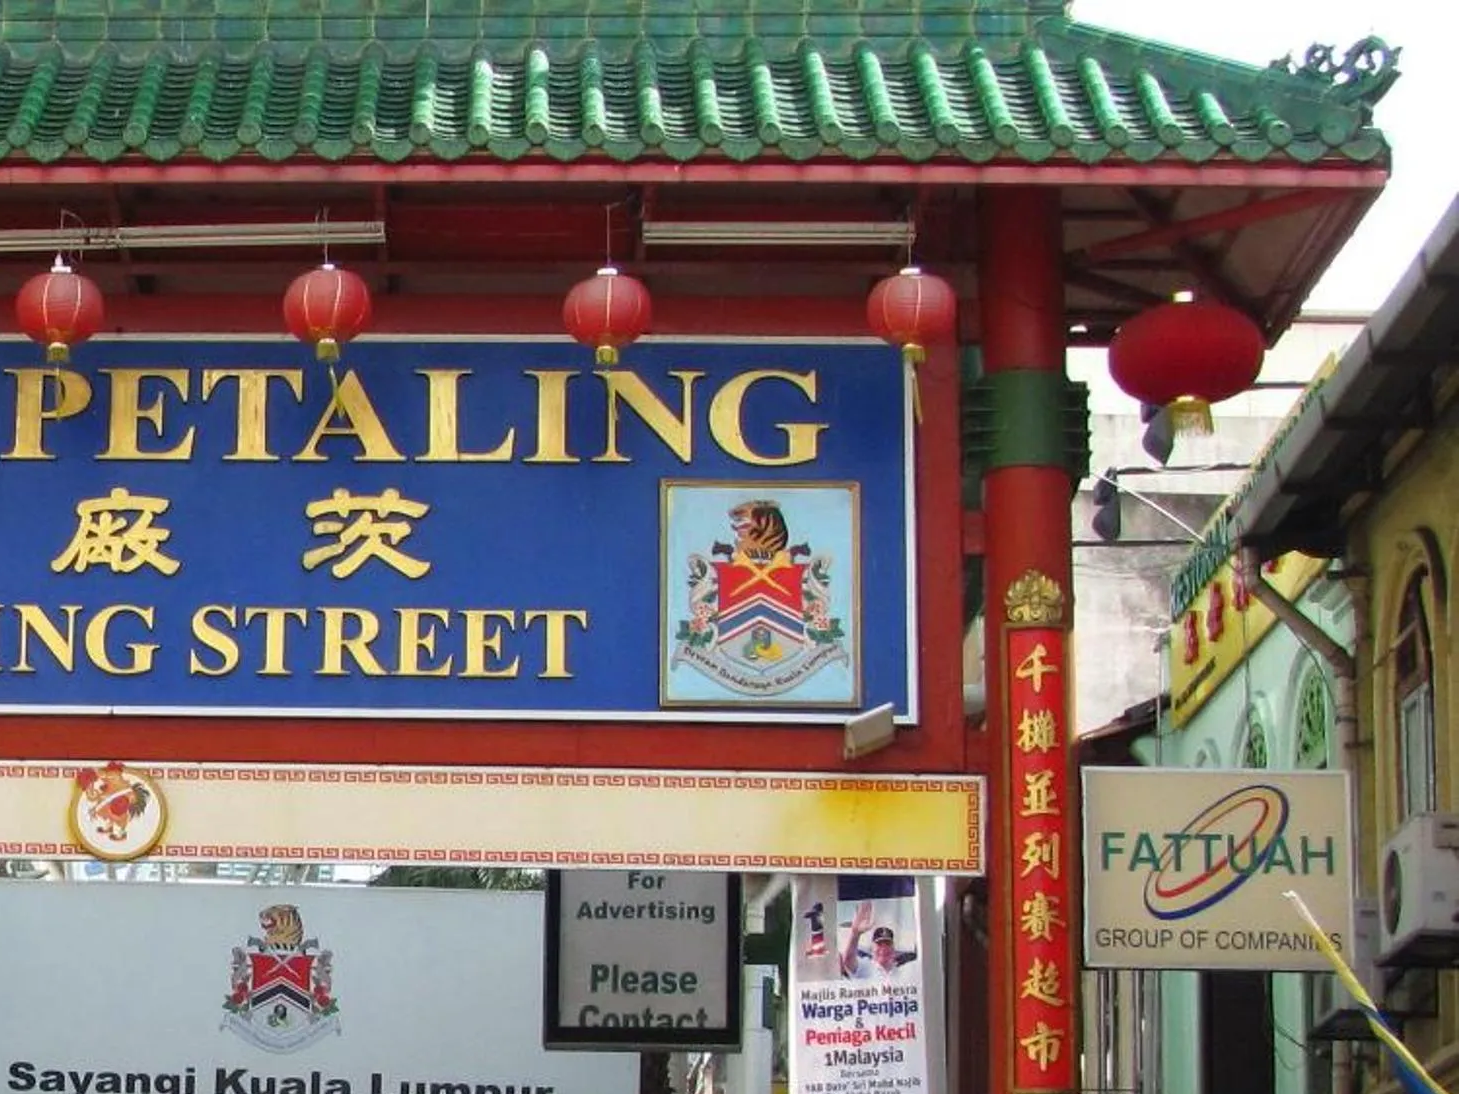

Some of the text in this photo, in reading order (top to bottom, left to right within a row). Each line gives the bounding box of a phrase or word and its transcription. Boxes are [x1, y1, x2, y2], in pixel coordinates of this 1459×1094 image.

[0, 366, 830, 467] PETALING
[190, 604, 588, 679] STREET
[1100, 831, 1336, 876] FATTUAH
[627, 871, 666, 890] For
[576, 901, 716, 924] Advertising
[1094, 927, 1343, 952] GROUP OF COMPANIS
[589, 963, 699, 995] Please
[839, 985, 879, 999] Ramah
[882, 984, 918, 997] Mesra
[578, 1004, 709, 1028] Contact
[801, 997, 919, 1021] Warga Penjaja
[805, 1022, 916, 1047] Peniaga Kecil
[854, 1017, 864, 1029] &
[824, 1046, 904, 1068] 1Malaysia
